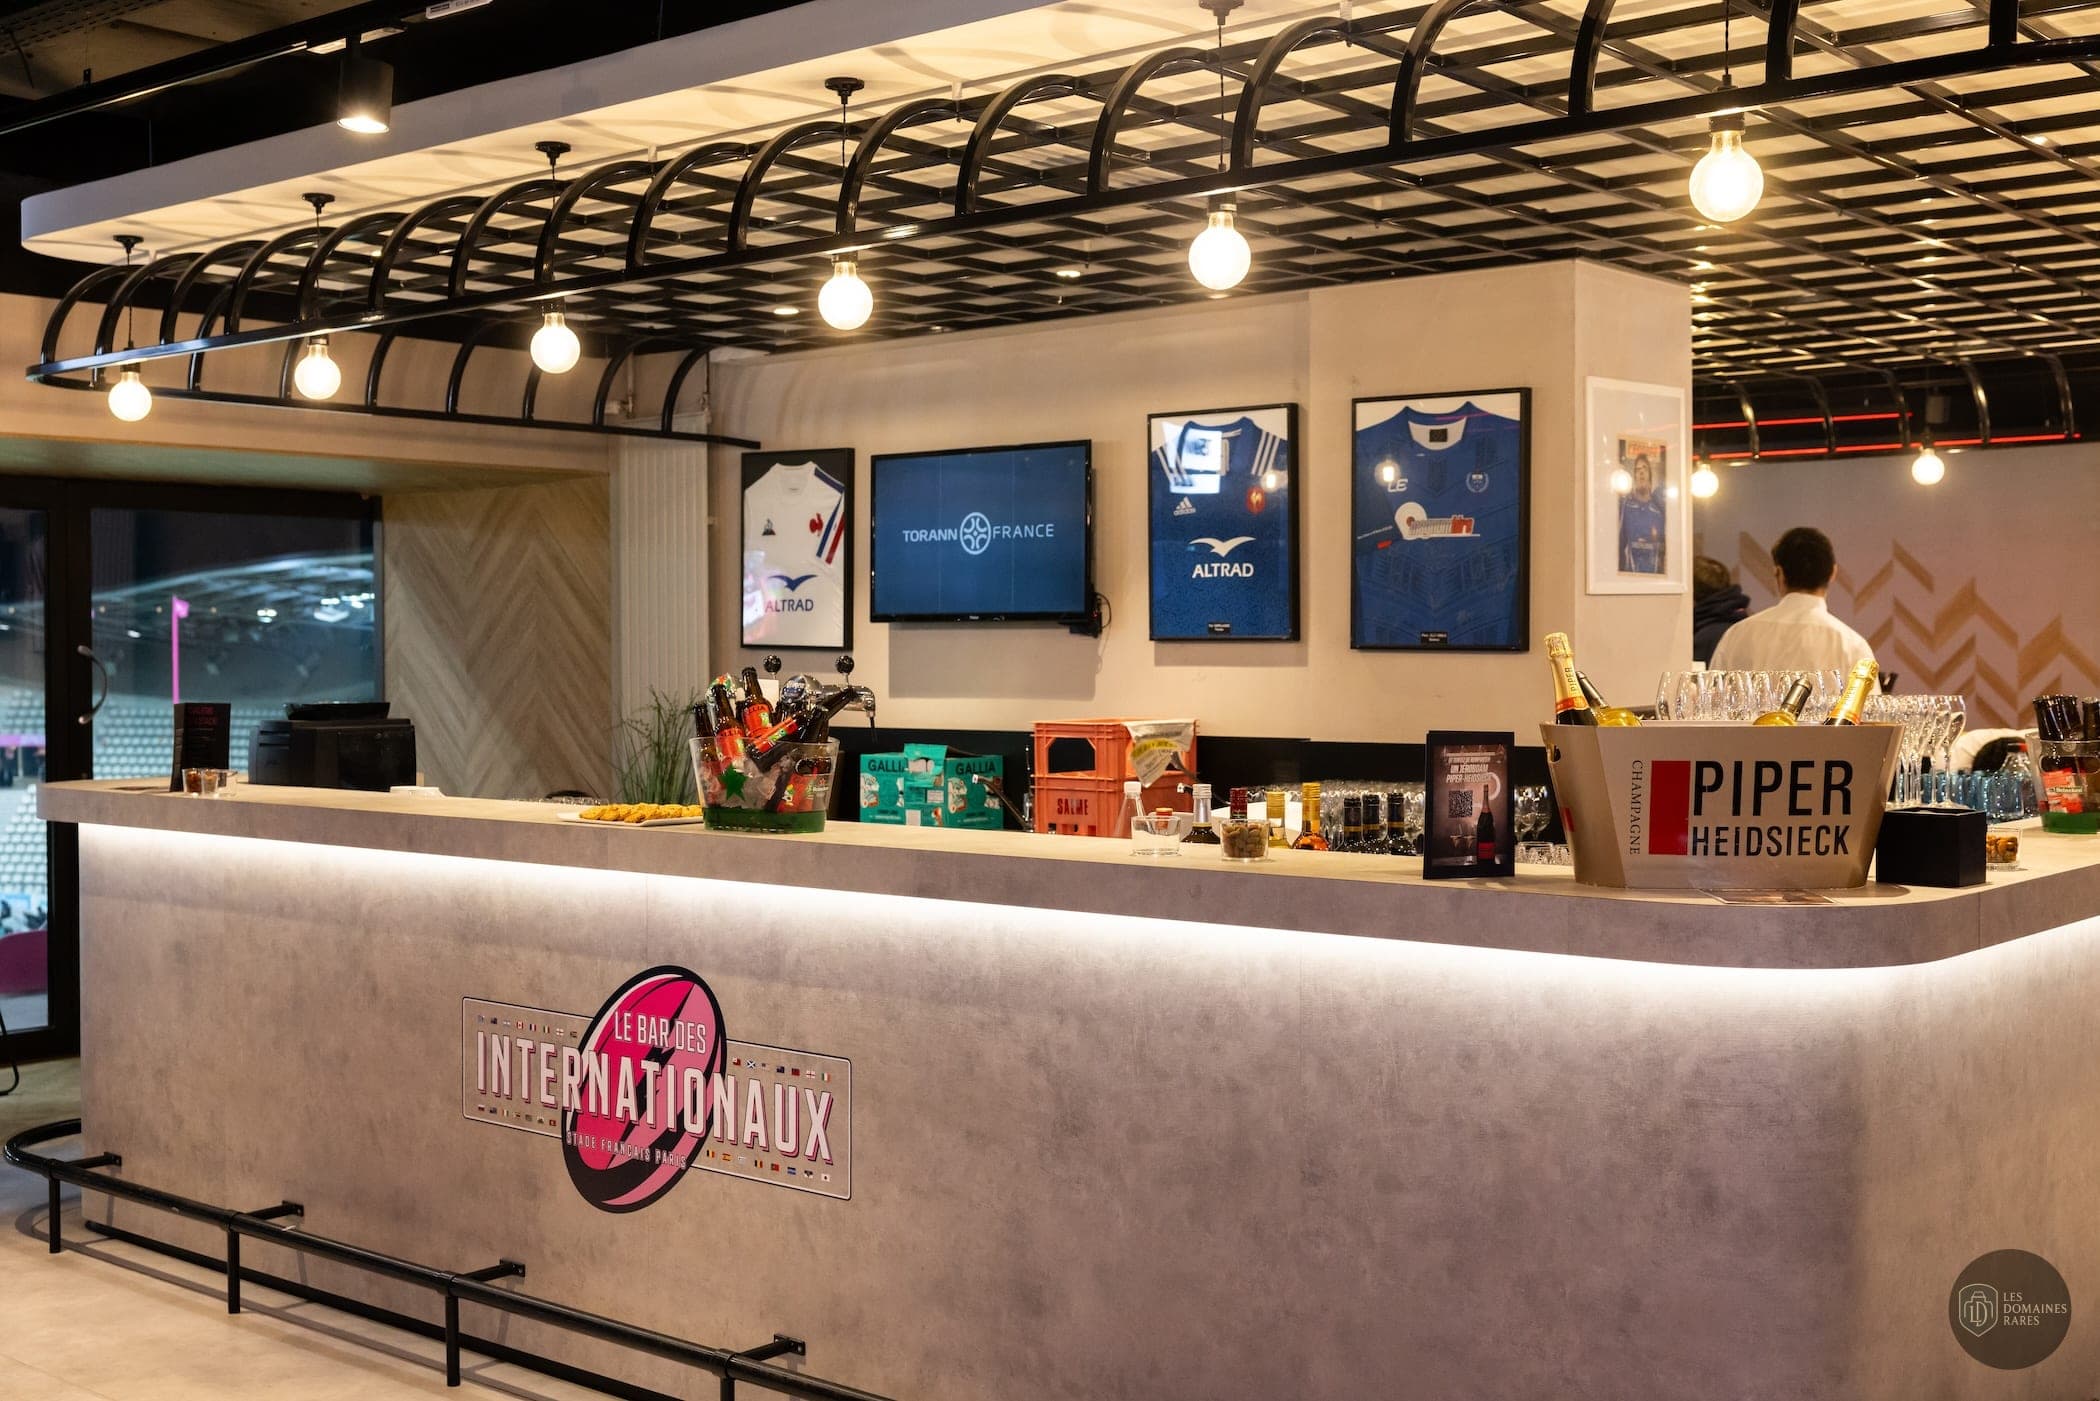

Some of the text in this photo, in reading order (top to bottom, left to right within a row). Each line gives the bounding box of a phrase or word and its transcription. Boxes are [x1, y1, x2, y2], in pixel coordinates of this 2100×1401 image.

[902, 523, 1054, 543] TORANN FRANCE
[1191, 562, 1255, 579] ALTRAD
[764, 598, 814, 614] ALTRAD
[955, 760, 996, 775] GALLIA
[1692, 760, 1855, 817] PIPER
[1629, 759, 1643, 857] CHAMPAGNE
[1691, 825, 1851, 857] HEIDSIECK
[614, 1009, 708, 1055] LE BAR DES
[475, 1029, 834, 1166] INTERNATIONAUX
[566, 1130, 597, 1149] STADE
[655, 1148, 688, 1170] PARIS
